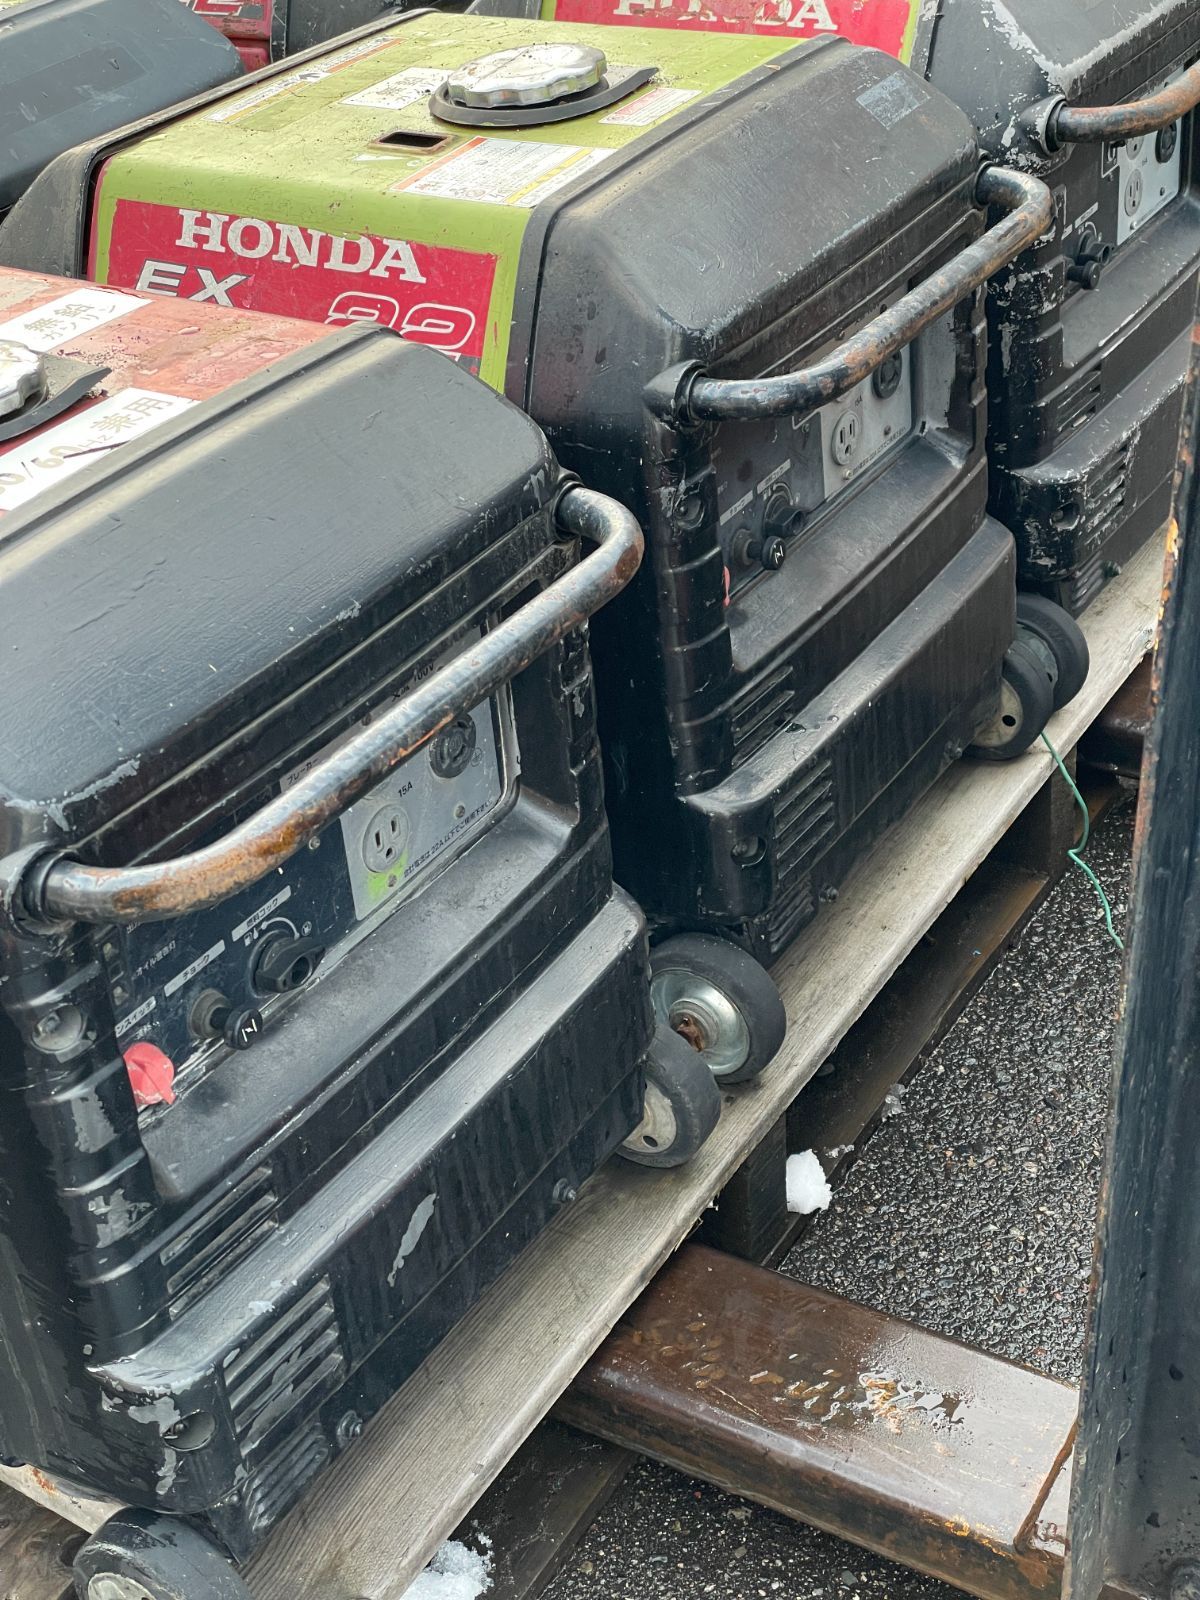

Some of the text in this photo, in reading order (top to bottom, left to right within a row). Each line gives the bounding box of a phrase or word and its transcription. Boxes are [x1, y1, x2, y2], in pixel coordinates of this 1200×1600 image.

[175, 208, 427, 284] HONDA
[135, 259, 249, 307] EX
[24, 303, 95, 335] 無鉛
[42, 304, 116, 341] ガソリン
[0, 396, 173, 494] 0/60Hz兼用
[286, 758, 320, 785] ブレーカー
[397, 780, 414, 798] 15A
[182, 953, 210, 981] チョーク
